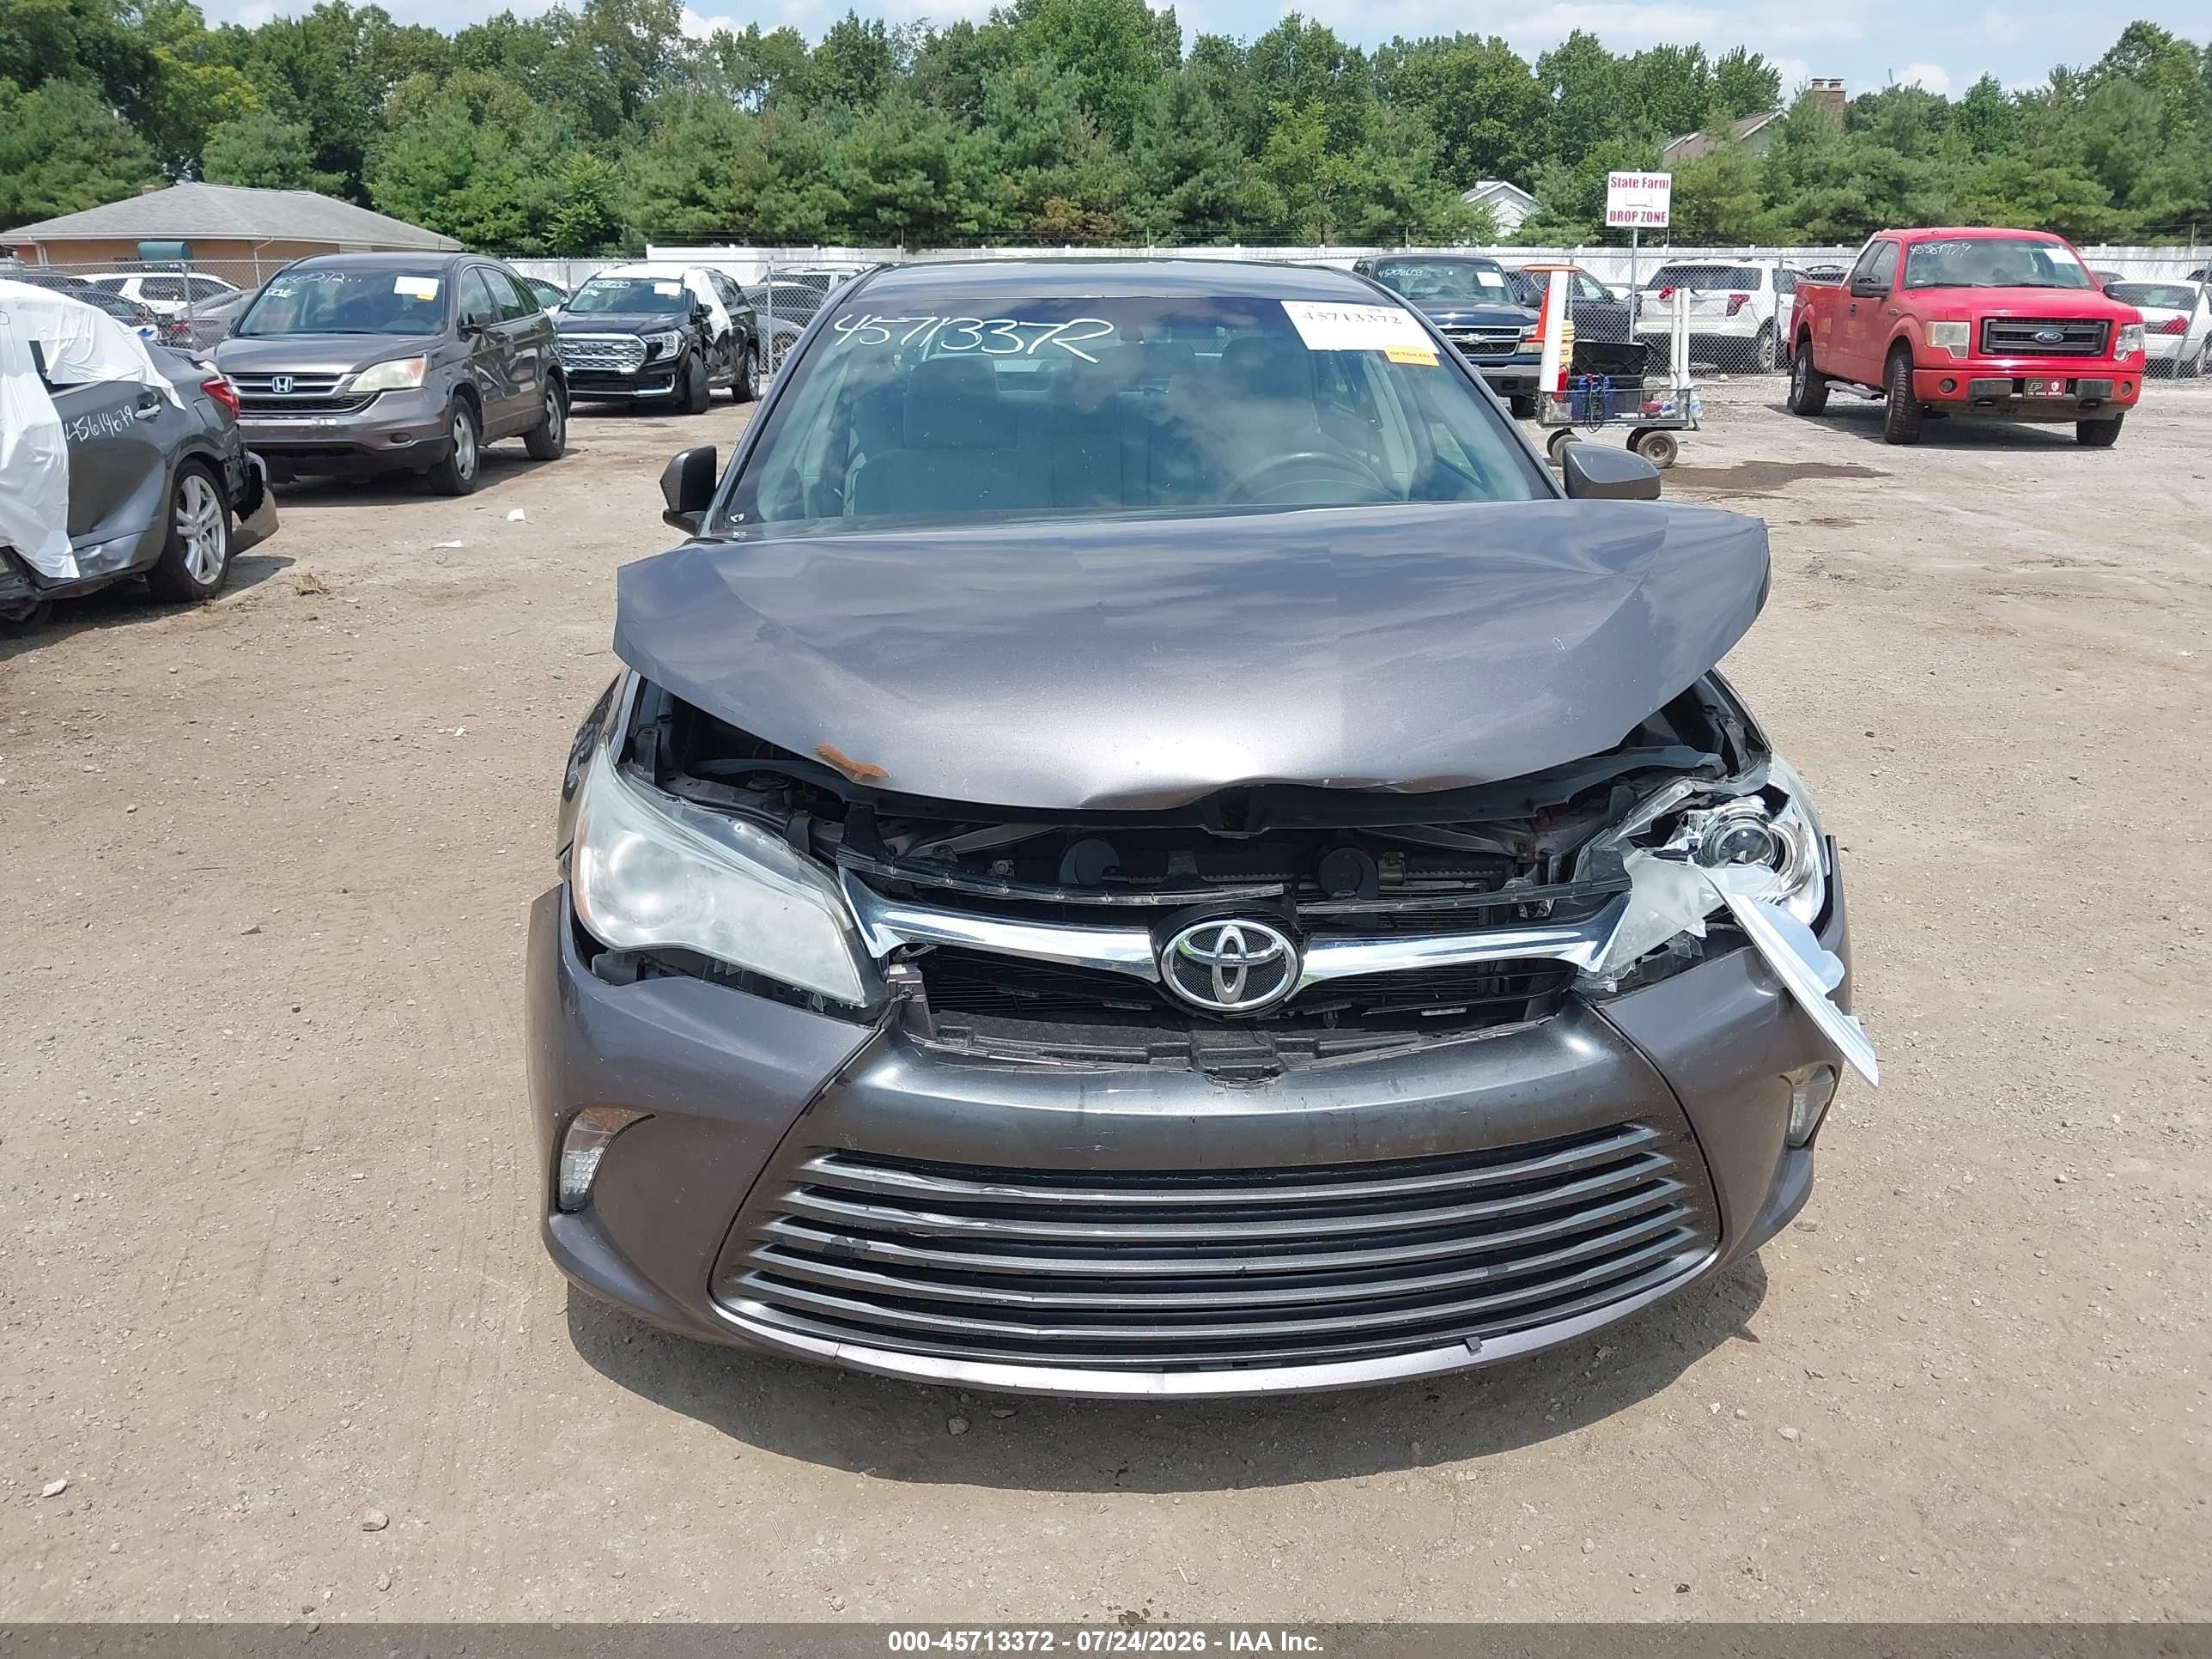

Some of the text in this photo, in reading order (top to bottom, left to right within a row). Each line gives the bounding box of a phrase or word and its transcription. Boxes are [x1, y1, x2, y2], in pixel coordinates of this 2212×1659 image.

[1610, 176, 1669, 189] State Farm
[1609, 210, 1667, 222] DROP ZONE
[1303, 312, 1402, 325] 45713372
[65, 405, 136, 443] 45614679
